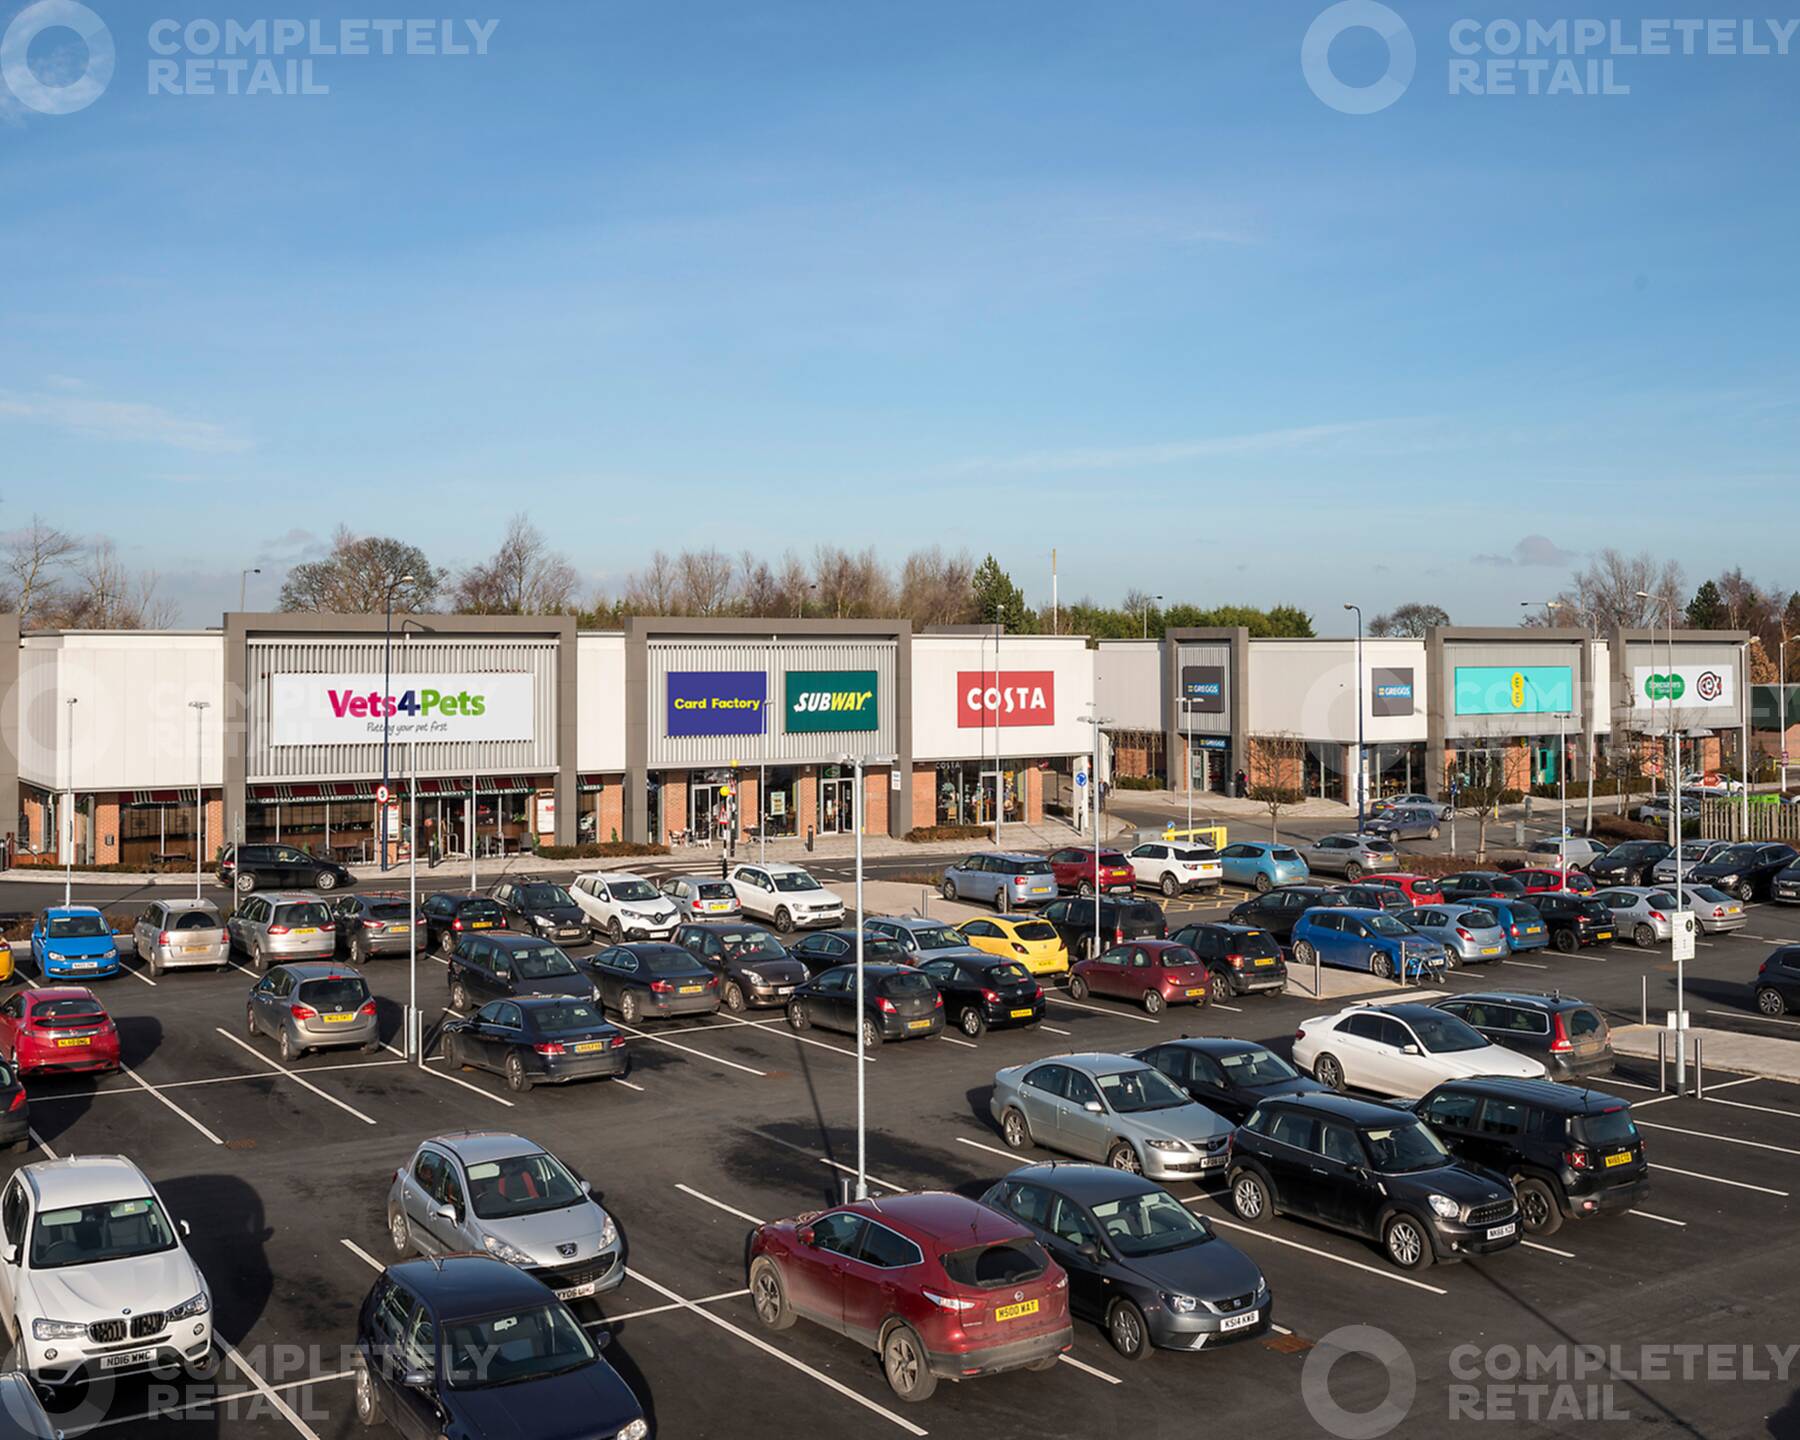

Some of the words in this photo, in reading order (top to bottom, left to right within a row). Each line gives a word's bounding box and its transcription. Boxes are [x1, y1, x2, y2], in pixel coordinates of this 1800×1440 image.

[1193, 685, 1218, 693] GREGGS
[1384, 687, 1410, 695] GREGGS
[327, 689, 486, 718] Vets4Pets
[674, 698, 707, 710] Card
[711, 698, 760, 711] Factory
[793, 691, 873, 712] SUBWAY
[967, 687, 1047, 713] COSTA
[396, 723, 413, 736] your
[415, 722, 429, 733] pet
[430, 720, 447, 732] first
[935, 762, 960, 770] COSTA
[106, 1355, 130, 1367] ND16
